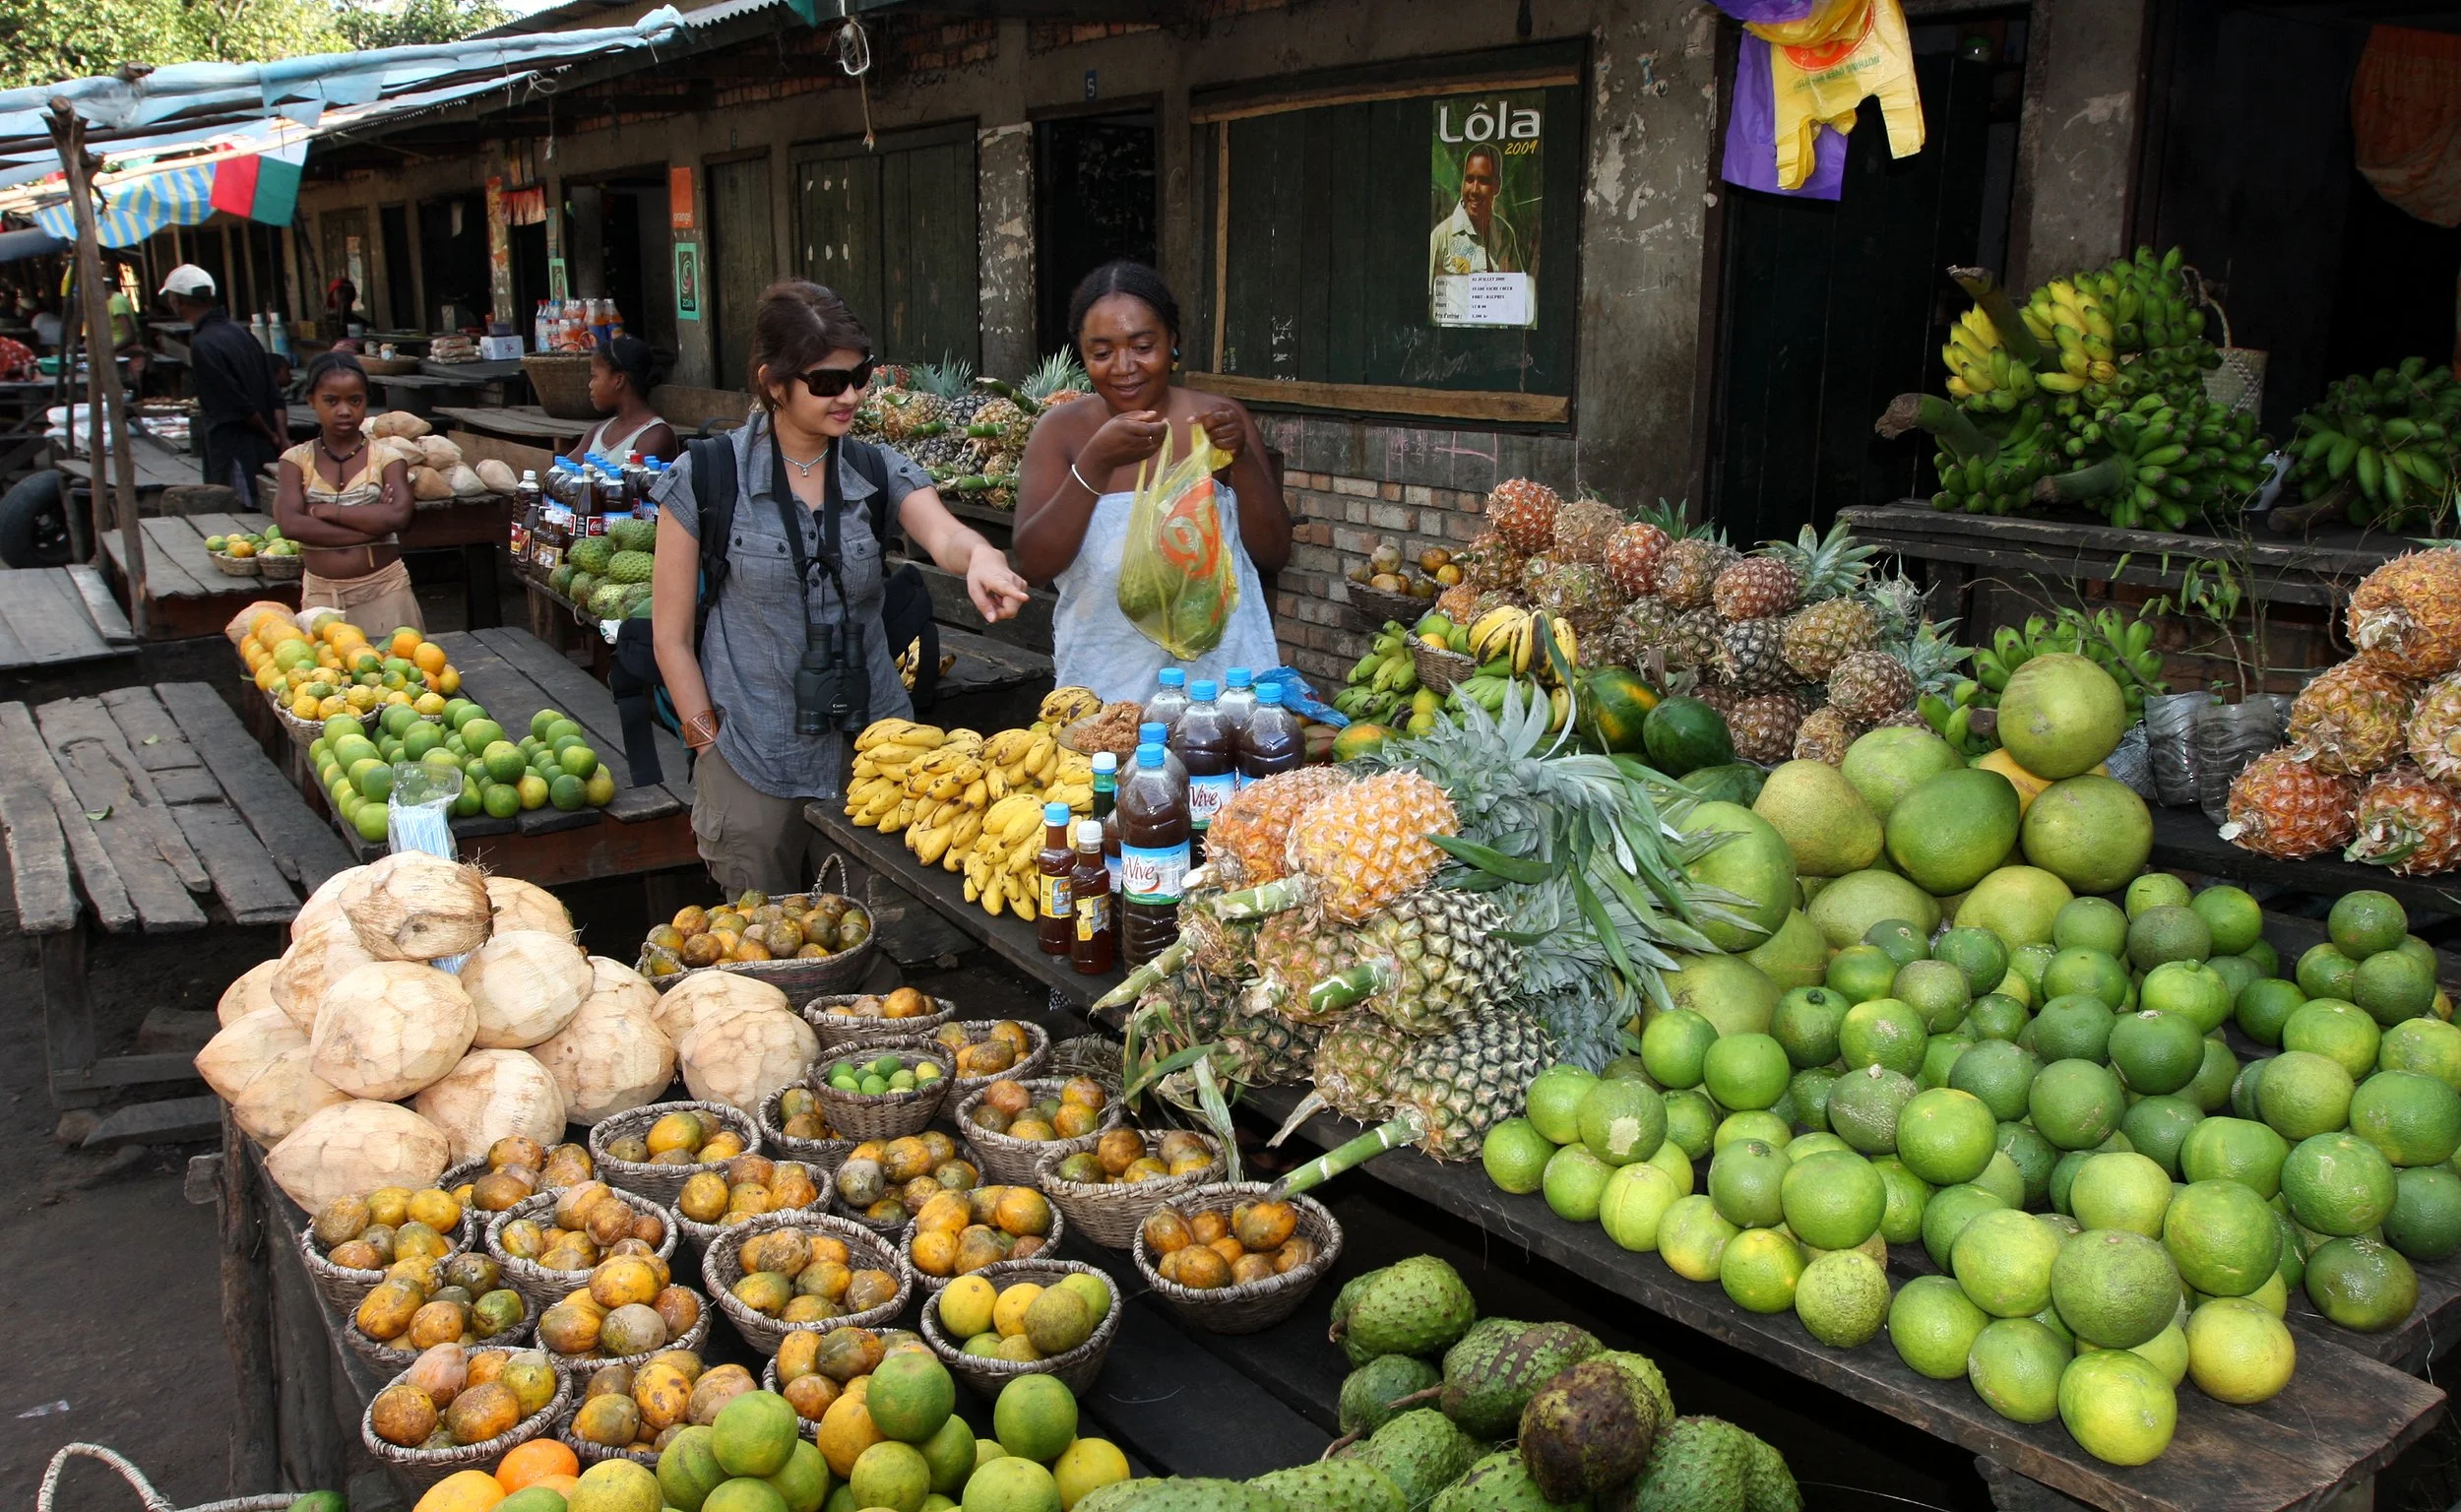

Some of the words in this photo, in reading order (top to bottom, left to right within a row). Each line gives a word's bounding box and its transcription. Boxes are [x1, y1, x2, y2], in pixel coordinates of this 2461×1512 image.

[1087, 78, 1095, 96] 5
[1439, 100, 1541, 143] Lôla
[1505, 140, 1538, 156] 2009
